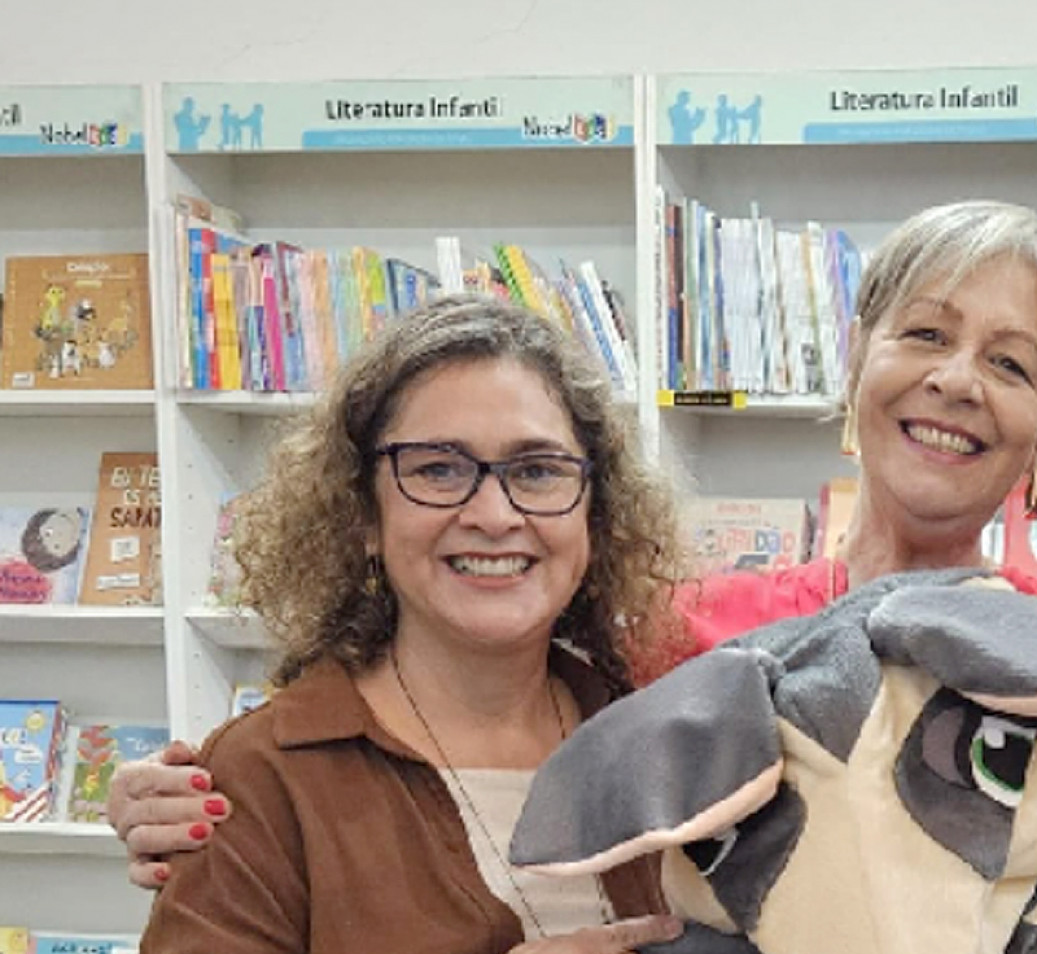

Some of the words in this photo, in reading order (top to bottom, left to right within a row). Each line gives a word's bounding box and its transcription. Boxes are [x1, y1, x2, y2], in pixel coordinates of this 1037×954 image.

[325, 99, 425, 120] Literatura
[830, 89, 933, 112] Literatura
[939, 84, 1018, 109] Infantil
